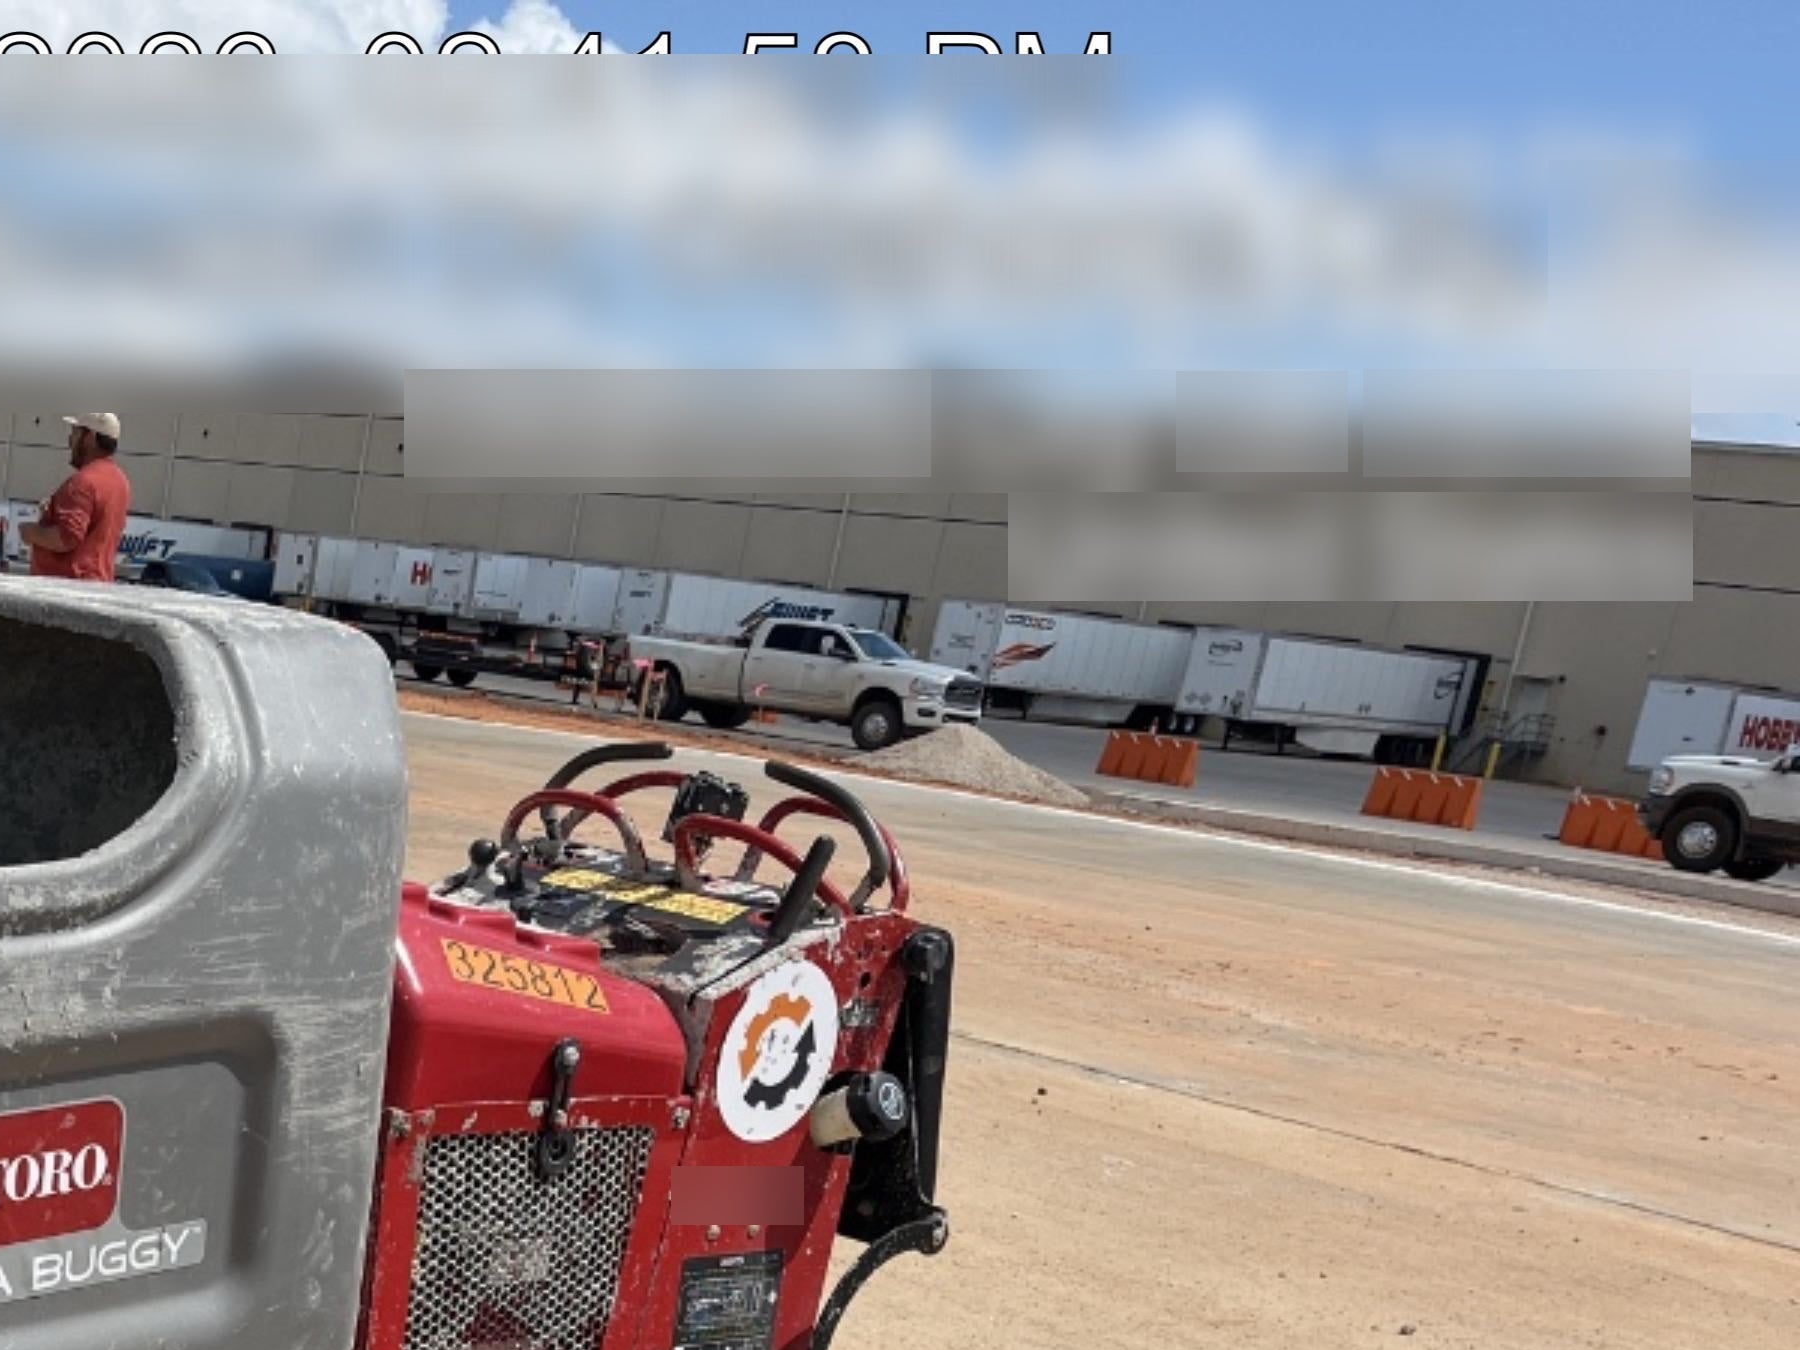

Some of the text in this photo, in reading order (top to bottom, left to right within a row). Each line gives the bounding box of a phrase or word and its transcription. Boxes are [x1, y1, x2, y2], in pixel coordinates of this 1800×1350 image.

[118, 534, 177, 558] WIFT
[446, 940, 608, 1012] 325812
[31, 1229, 191, 1292] BUGGY
